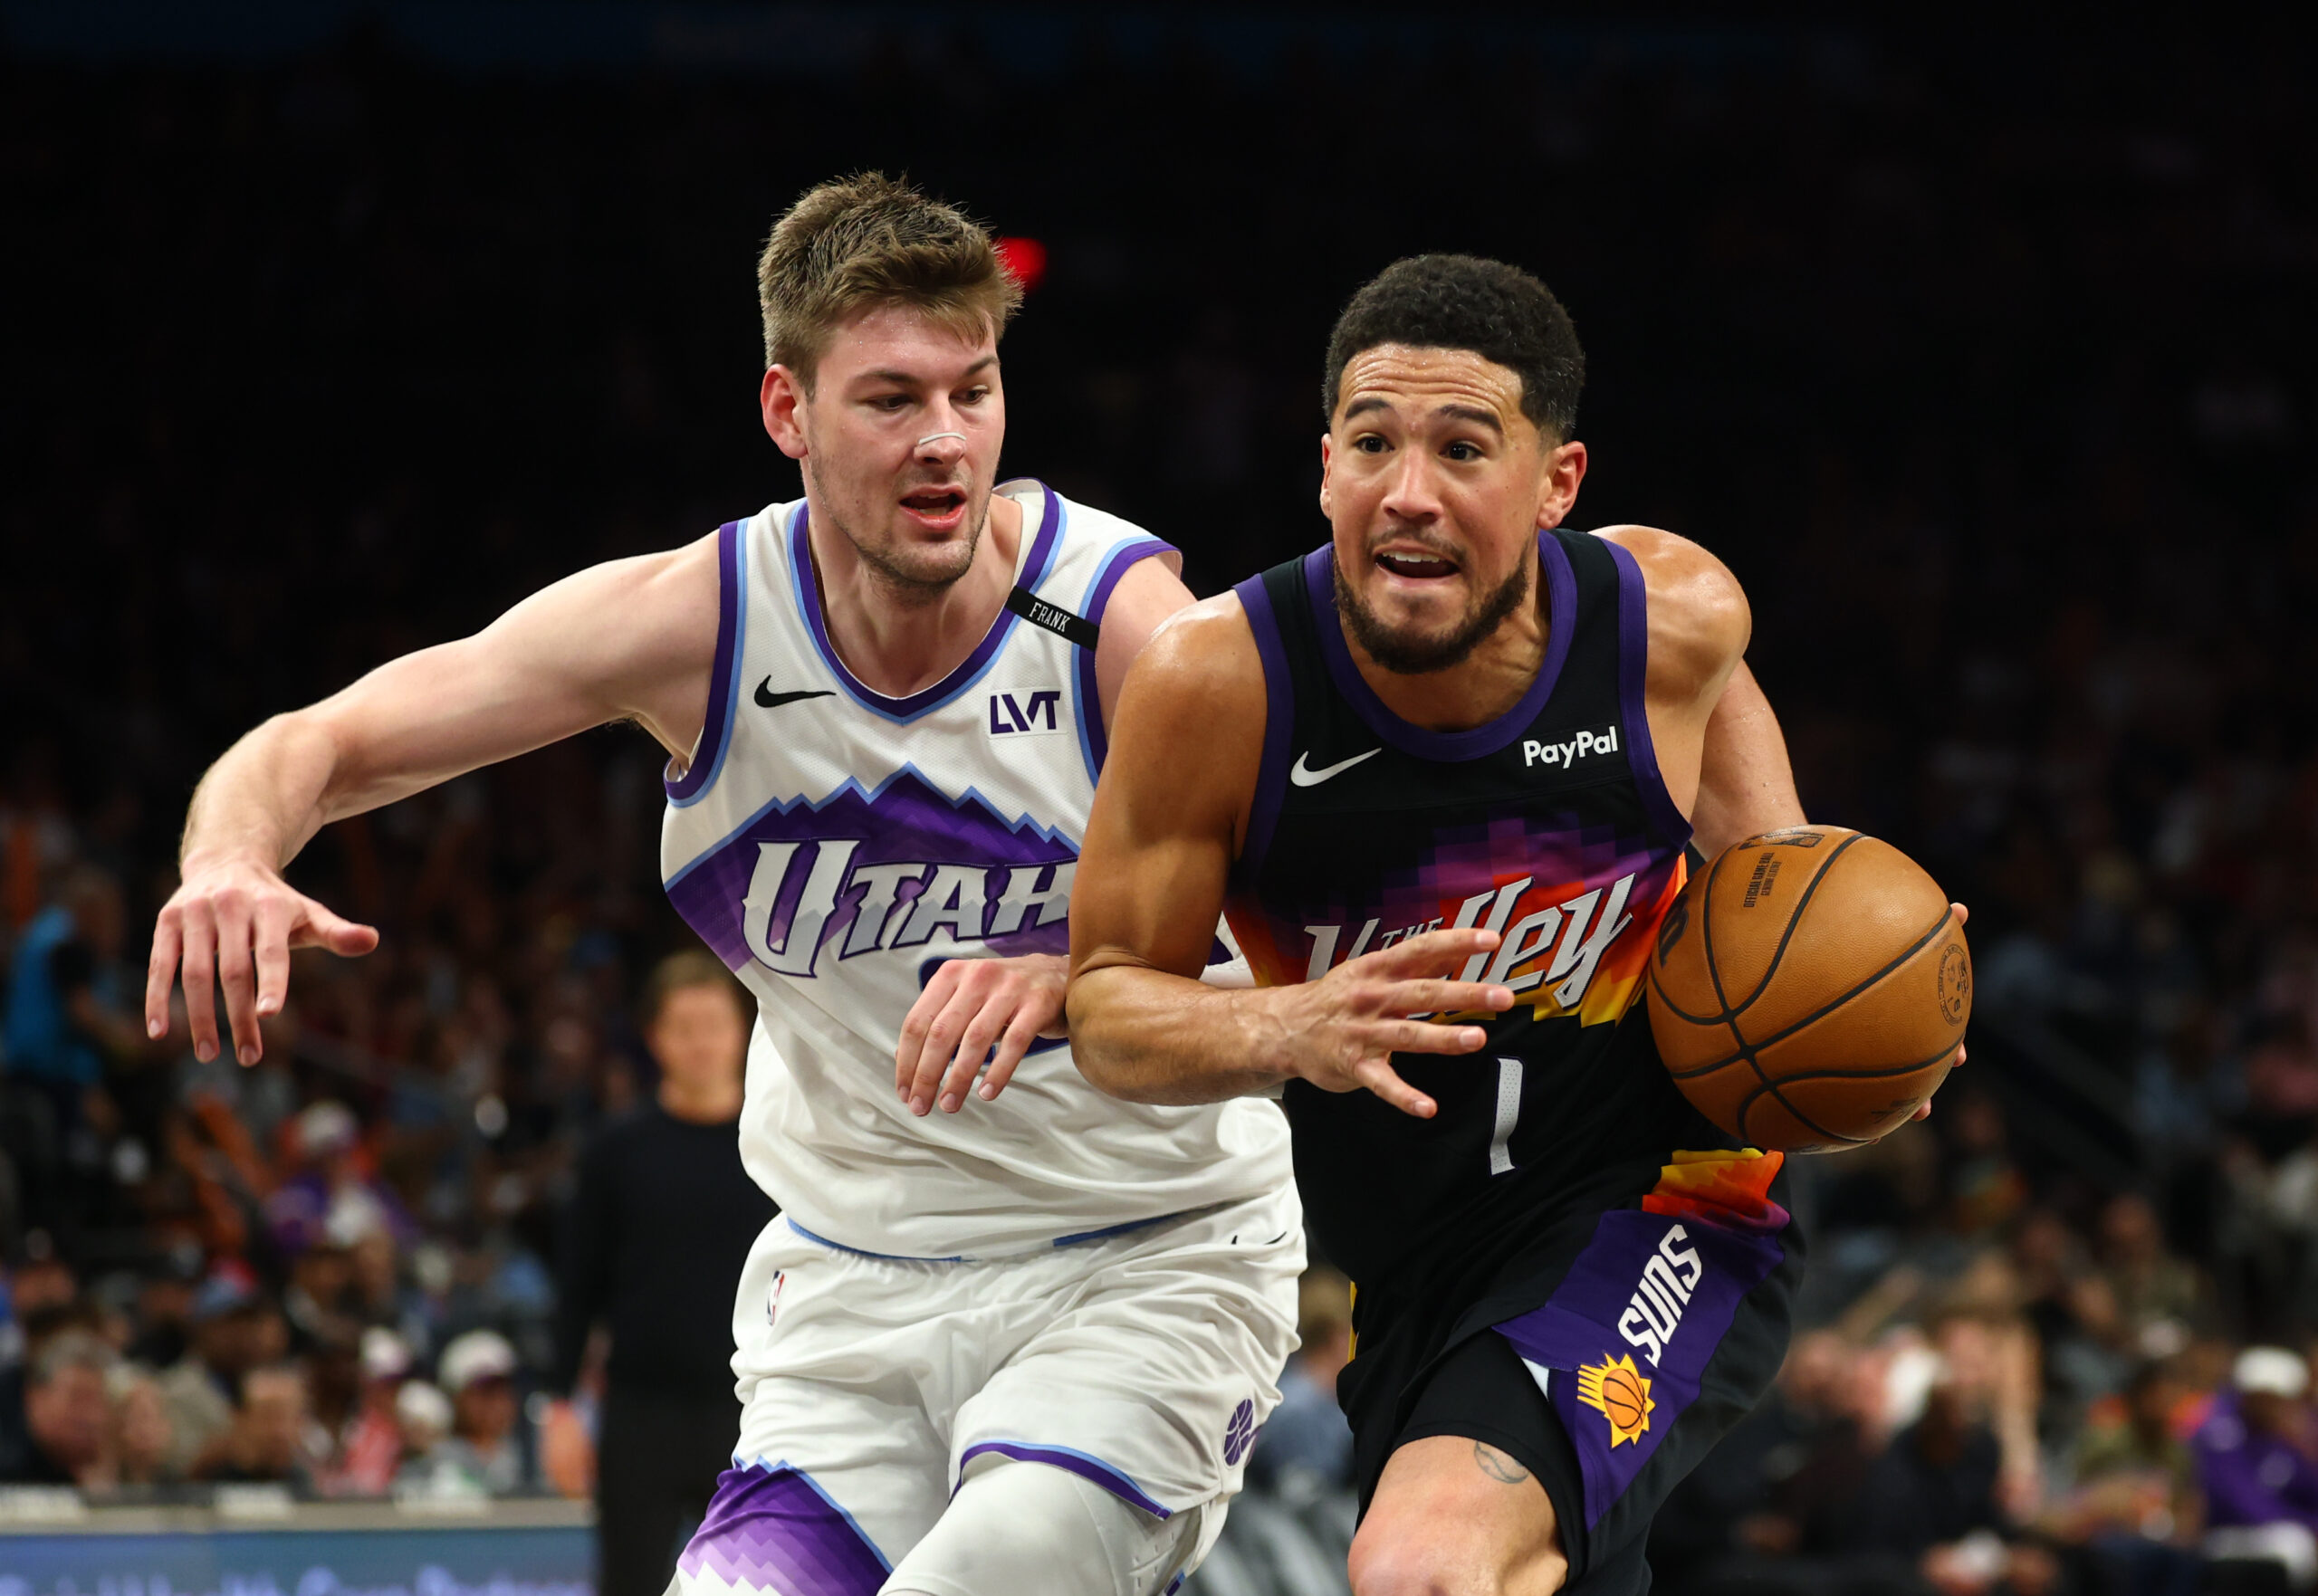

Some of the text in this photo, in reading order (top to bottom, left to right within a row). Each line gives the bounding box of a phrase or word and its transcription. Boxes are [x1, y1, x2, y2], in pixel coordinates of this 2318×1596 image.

[1029, 602, 1071, 633] FRANK
[990, 691, 1061, 735] LVT
[1523, 725, 1618, 769] PayPal
[1743, 880, 1762, 908] OFFICIAL
[1751, 864, 1768, 881] GAME
[742, 839, 1078, 979] UTAH
[1304, 873, 1637, 1014] Vlley
[1488, 1056, 1525, 1177] 1
[1617, 1223, 1702, 1369] SUNS
